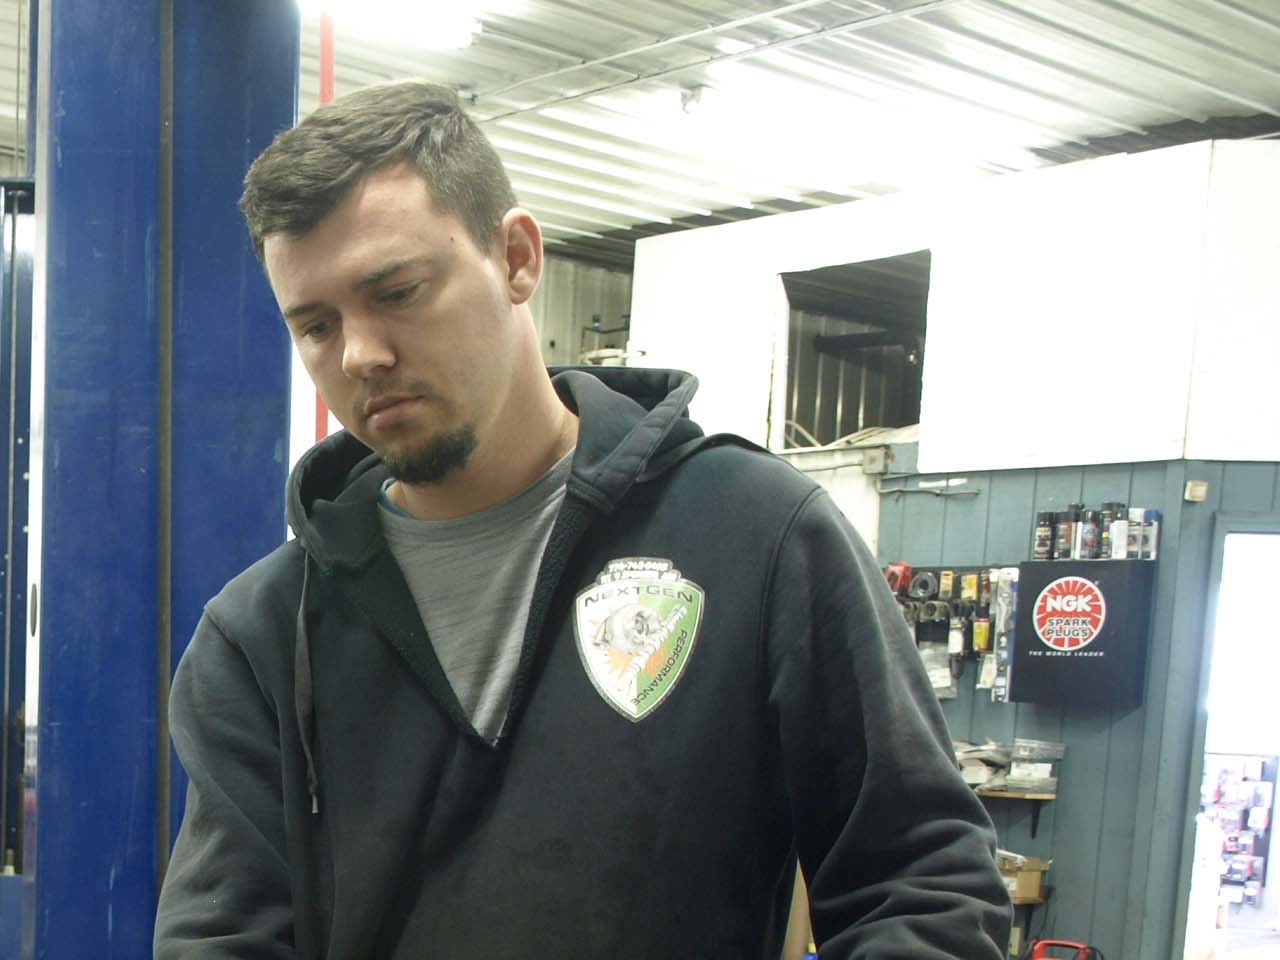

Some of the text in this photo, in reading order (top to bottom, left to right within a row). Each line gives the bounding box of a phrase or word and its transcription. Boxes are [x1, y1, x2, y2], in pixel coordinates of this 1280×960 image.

[584, 585, 693, 608] NEXTGEN
[1046, 594, 1092, 612] NGK
[1047, 618, 1090, 627] SPARK
[1046, 628, 1089, 637] PLUGS
[631, 629, 688, 706] PERFORMANCE
